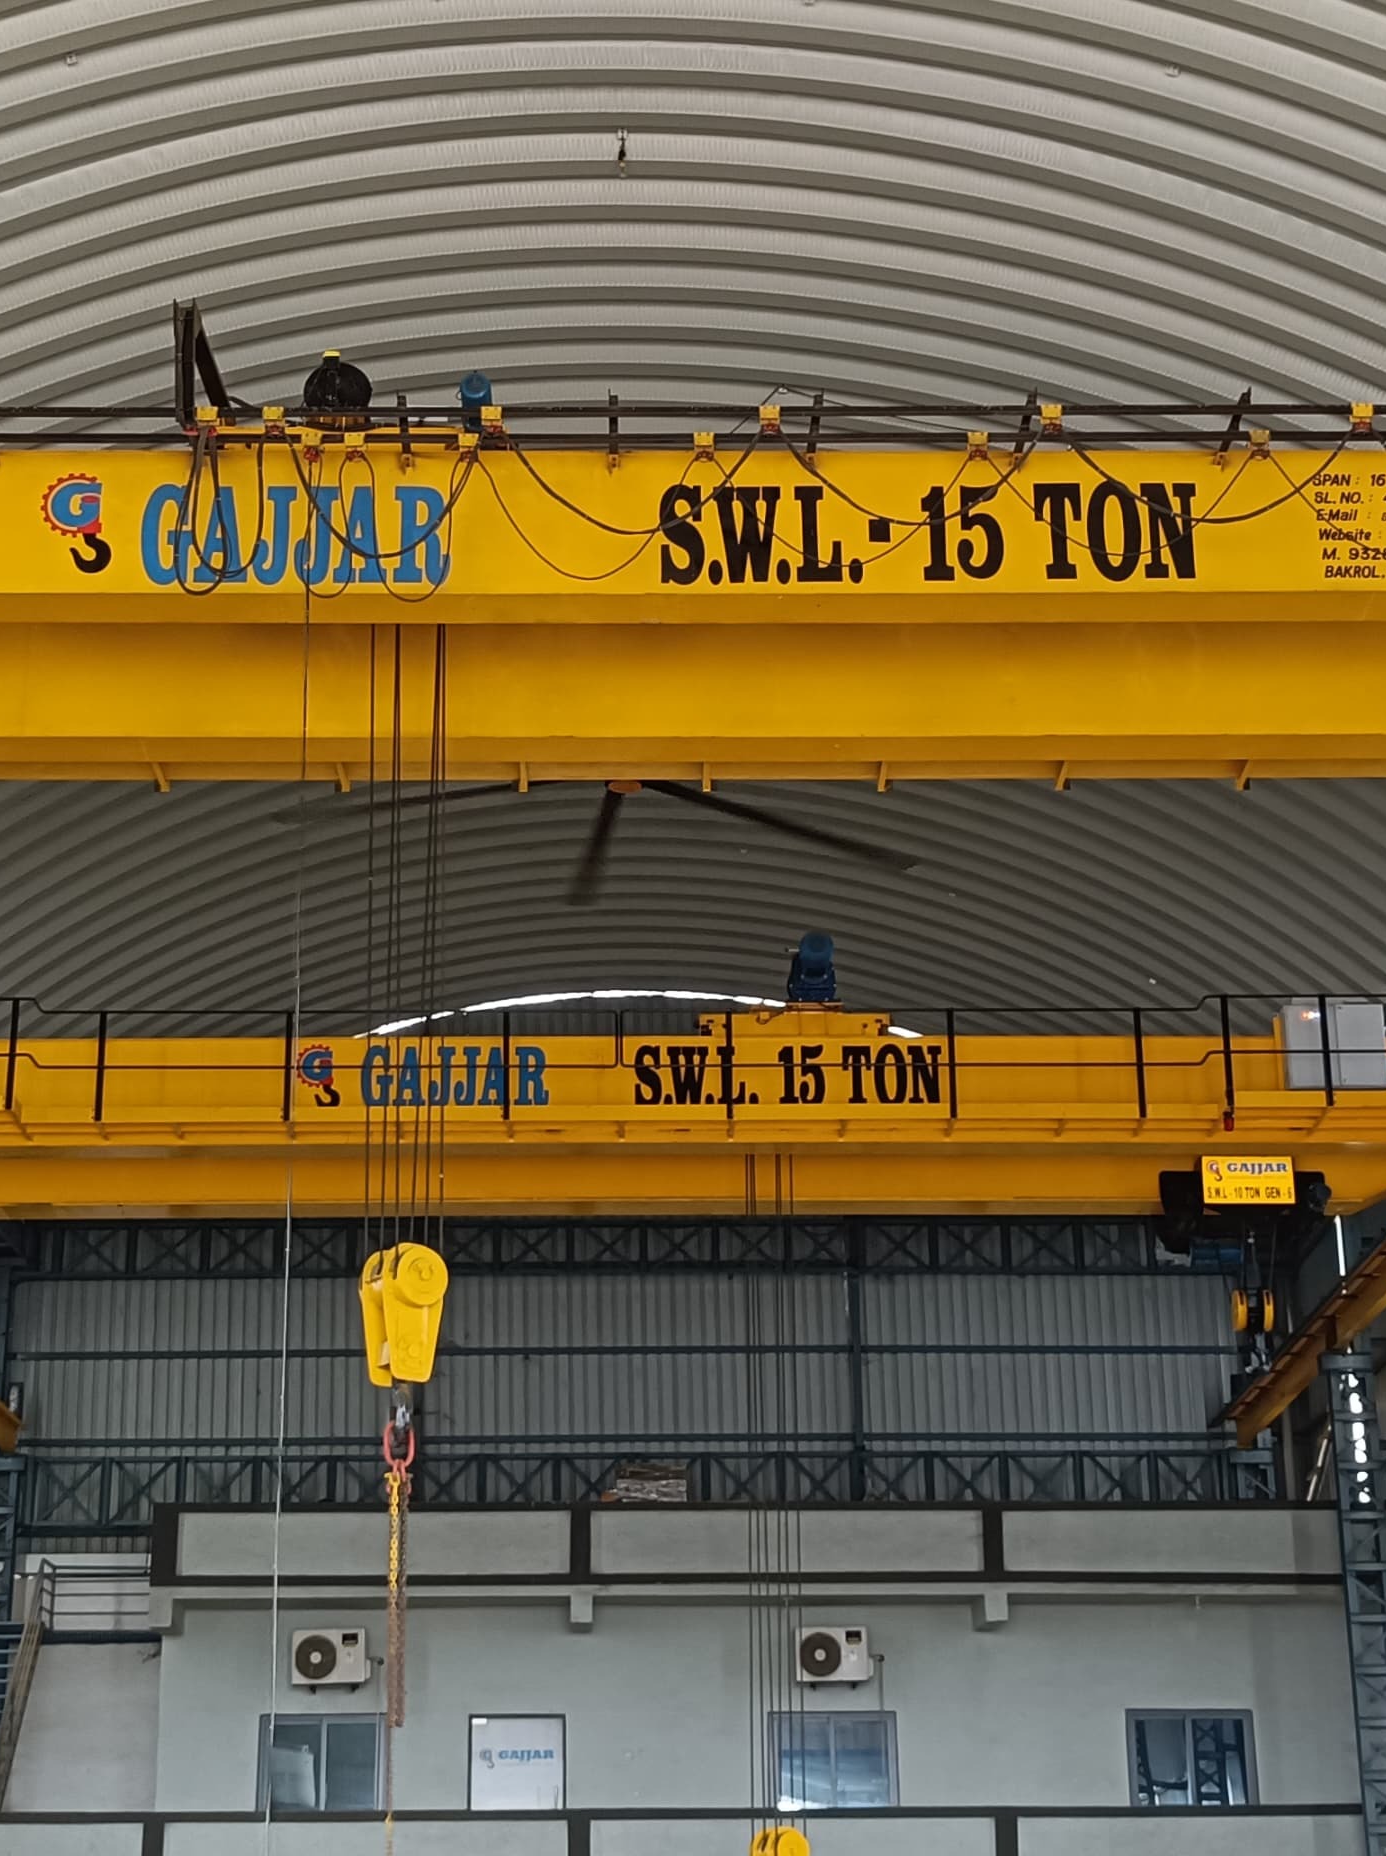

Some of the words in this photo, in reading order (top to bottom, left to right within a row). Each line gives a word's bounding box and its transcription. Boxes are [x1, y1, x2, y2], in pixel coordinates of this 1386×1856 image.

[1312, 473, 1351, 486] SPAN
[1314, 491, 1336, 504] SL.
[1340, 491, 1364, 504] NO.
[1316, 508, 1358, 522] E-Mail
[140, 483, 451, 586] GAJJAR
[659, 483, 863, 585] S.W.L.
[920, 485, 1004, 582] 15
[1034, 481, 1197, 582] TON
[1319, 528, 1372, 541] Website
[1322, 547, 1341, 560] M.
[362, 1045, 549, 1106] GAJJAR
[634, 1045, 759, 1106] S.W.L.
[778, 1044, 825, 1105] 15
[842, 1044, 942, 1105] TON
[1227, 1163, 1286, 1174] GAJJAR
[1245, 1186, 1260, 1198] TON
